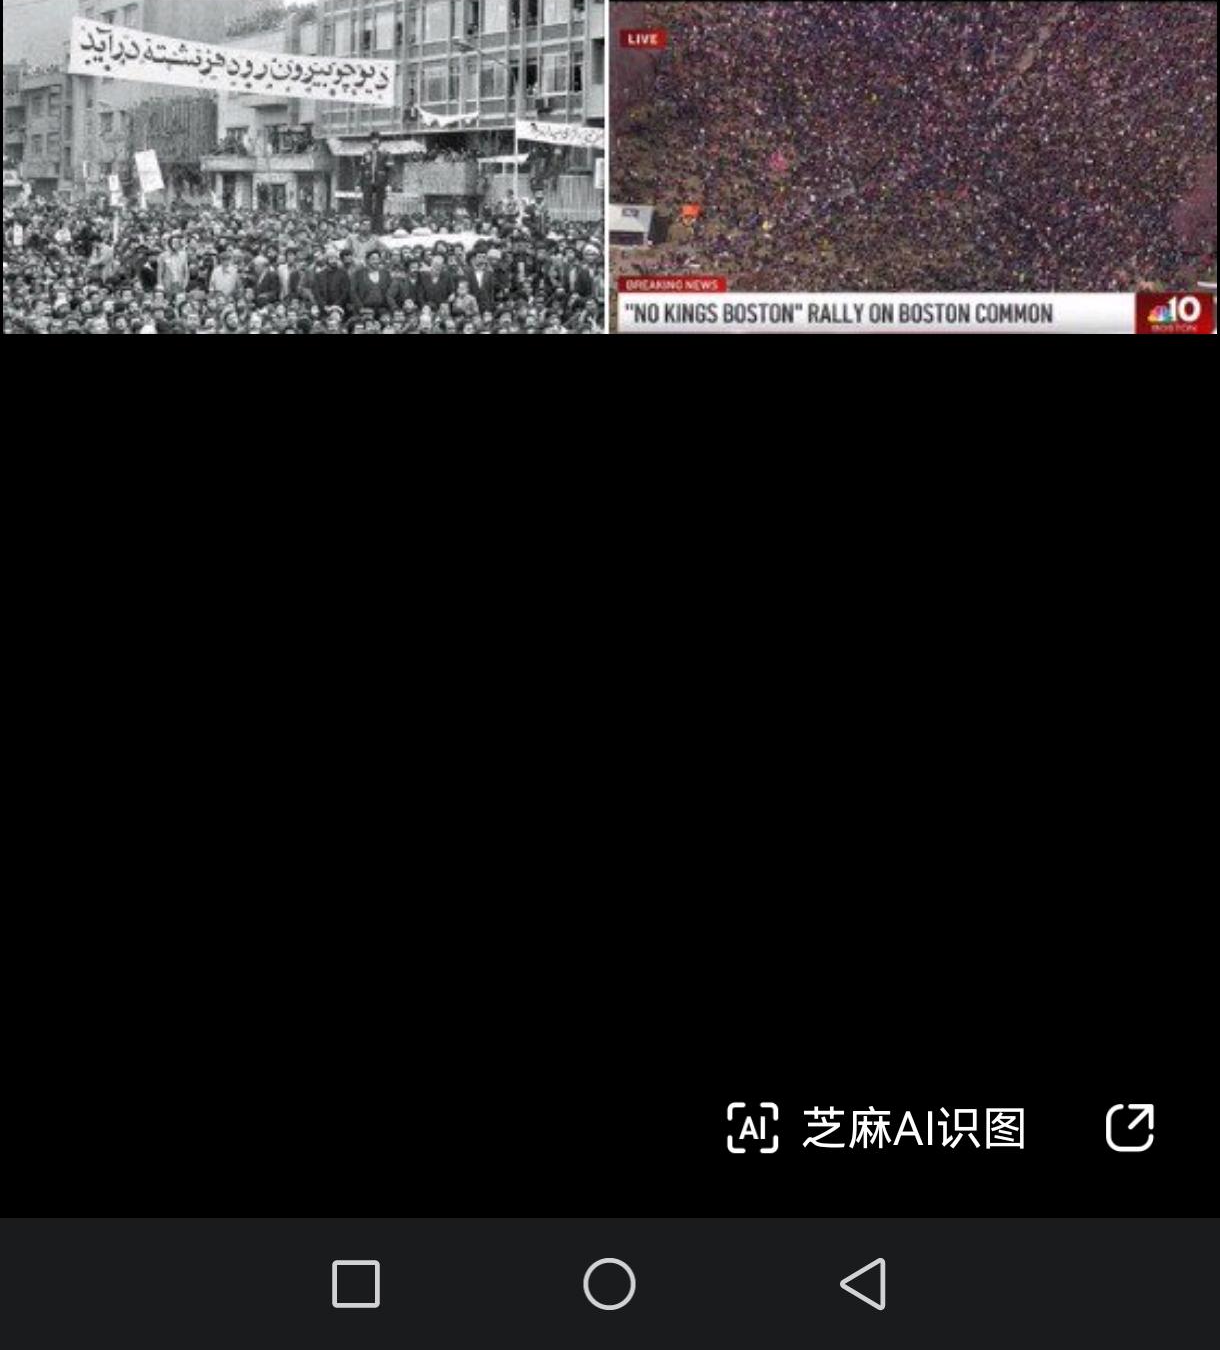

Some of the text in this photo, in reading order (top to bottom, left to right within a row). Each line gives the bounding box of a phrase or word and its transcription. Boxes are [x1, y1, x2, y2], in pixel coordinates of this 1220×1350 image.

[739, 1116, 766, 1139] AI
[802, 1105, 1026, 1149] 芝麻AI识图
